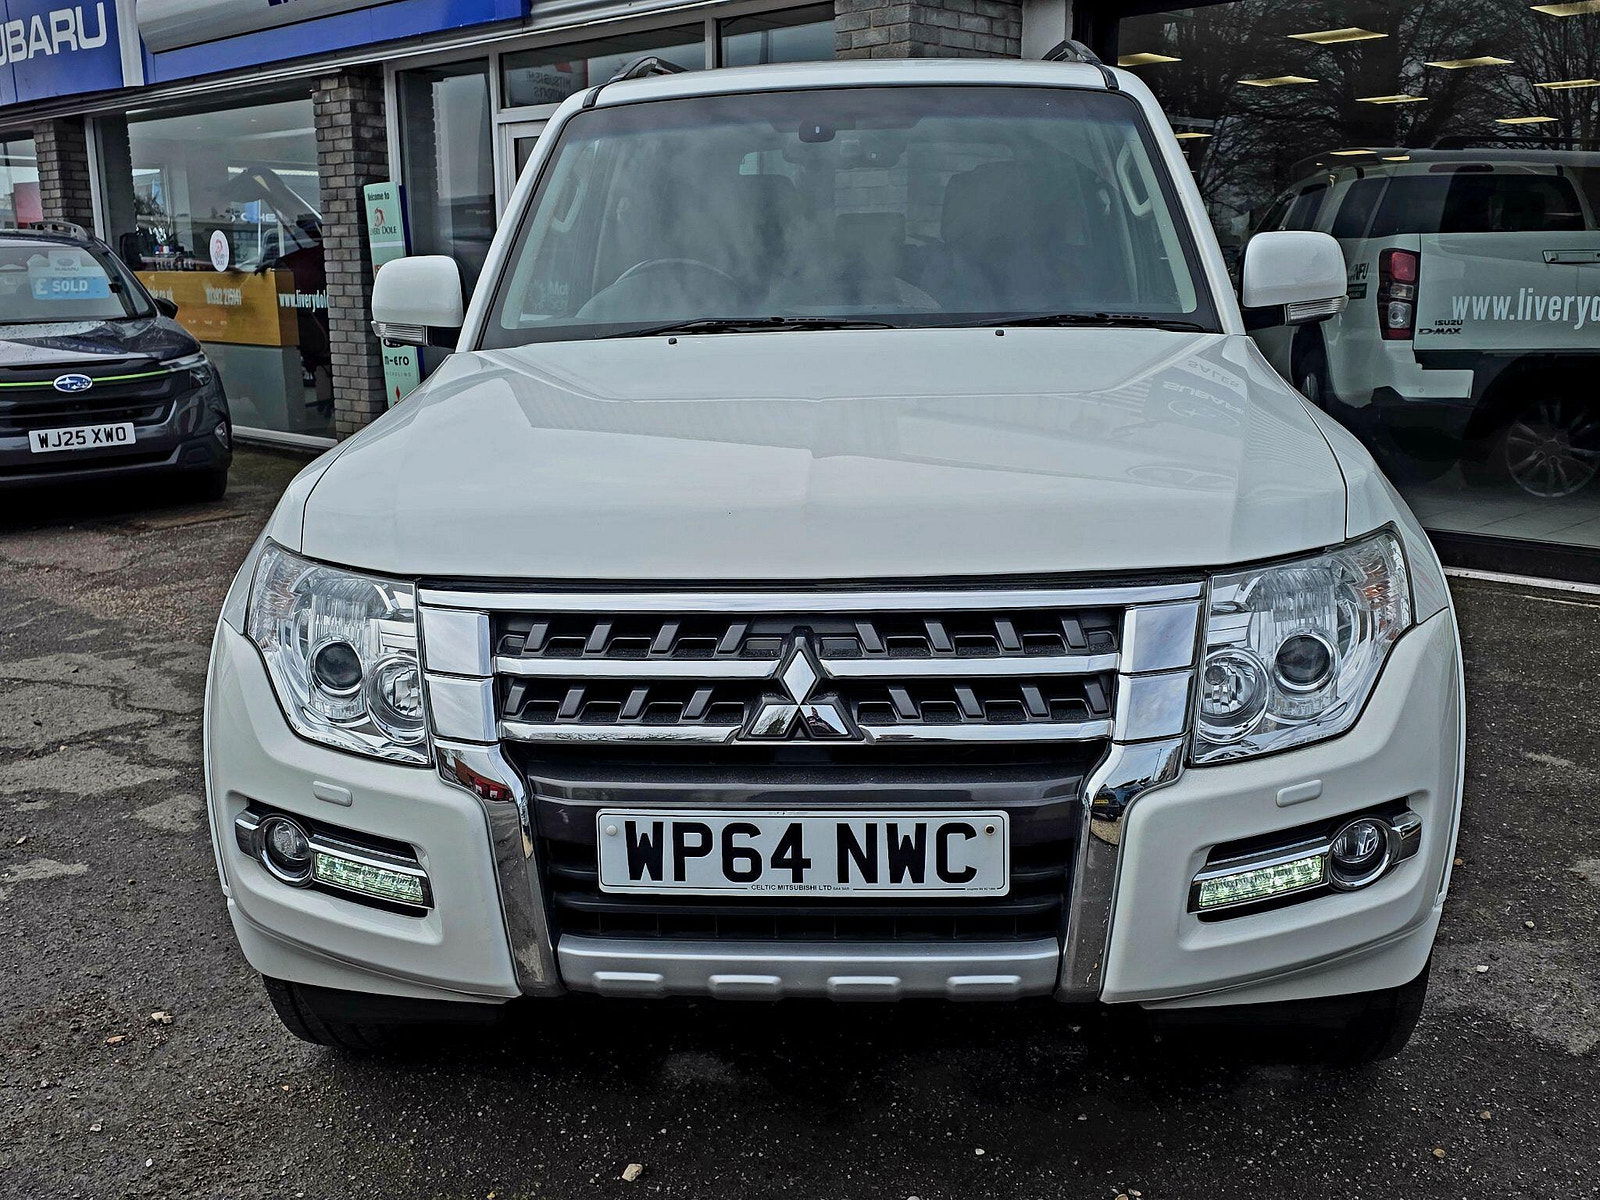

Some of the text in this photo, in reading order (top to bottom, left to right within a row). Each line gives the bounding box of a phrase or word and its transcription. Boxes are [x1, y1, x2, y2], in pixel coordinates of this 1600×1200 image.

[52, 280, 88, 292] SOLD
[38, 427, 126, 449] WJ25 XWO
[624, 820, 978, 884] WP64 NWC
